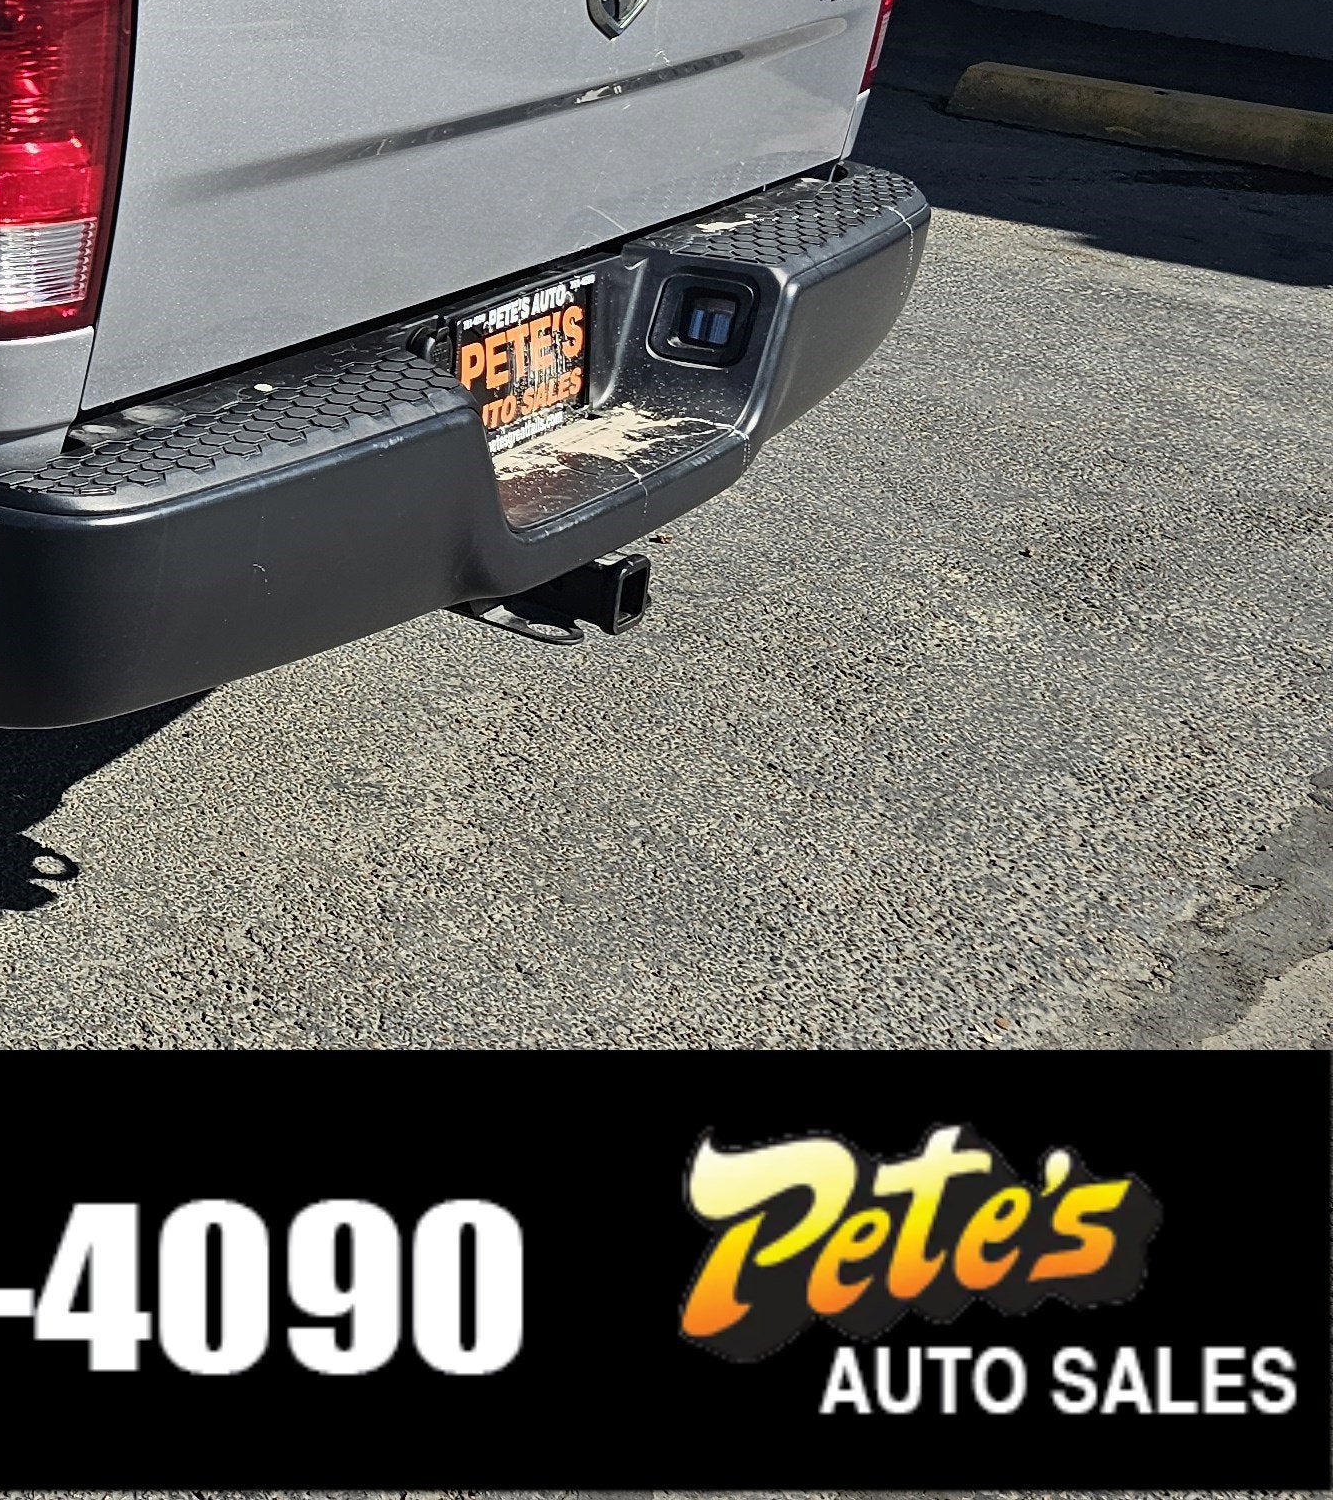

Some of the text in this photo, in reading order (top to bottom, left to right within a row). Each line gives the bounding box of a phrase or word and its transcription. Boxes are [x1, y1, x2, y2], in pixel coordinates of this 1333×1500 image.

[488, 297, 531, 331] PETE'S
[531, 284, 567, 316] AUTO
[461, 305, 584, 391] PETE'S
[482, 366, 583, 429] TO SALES
